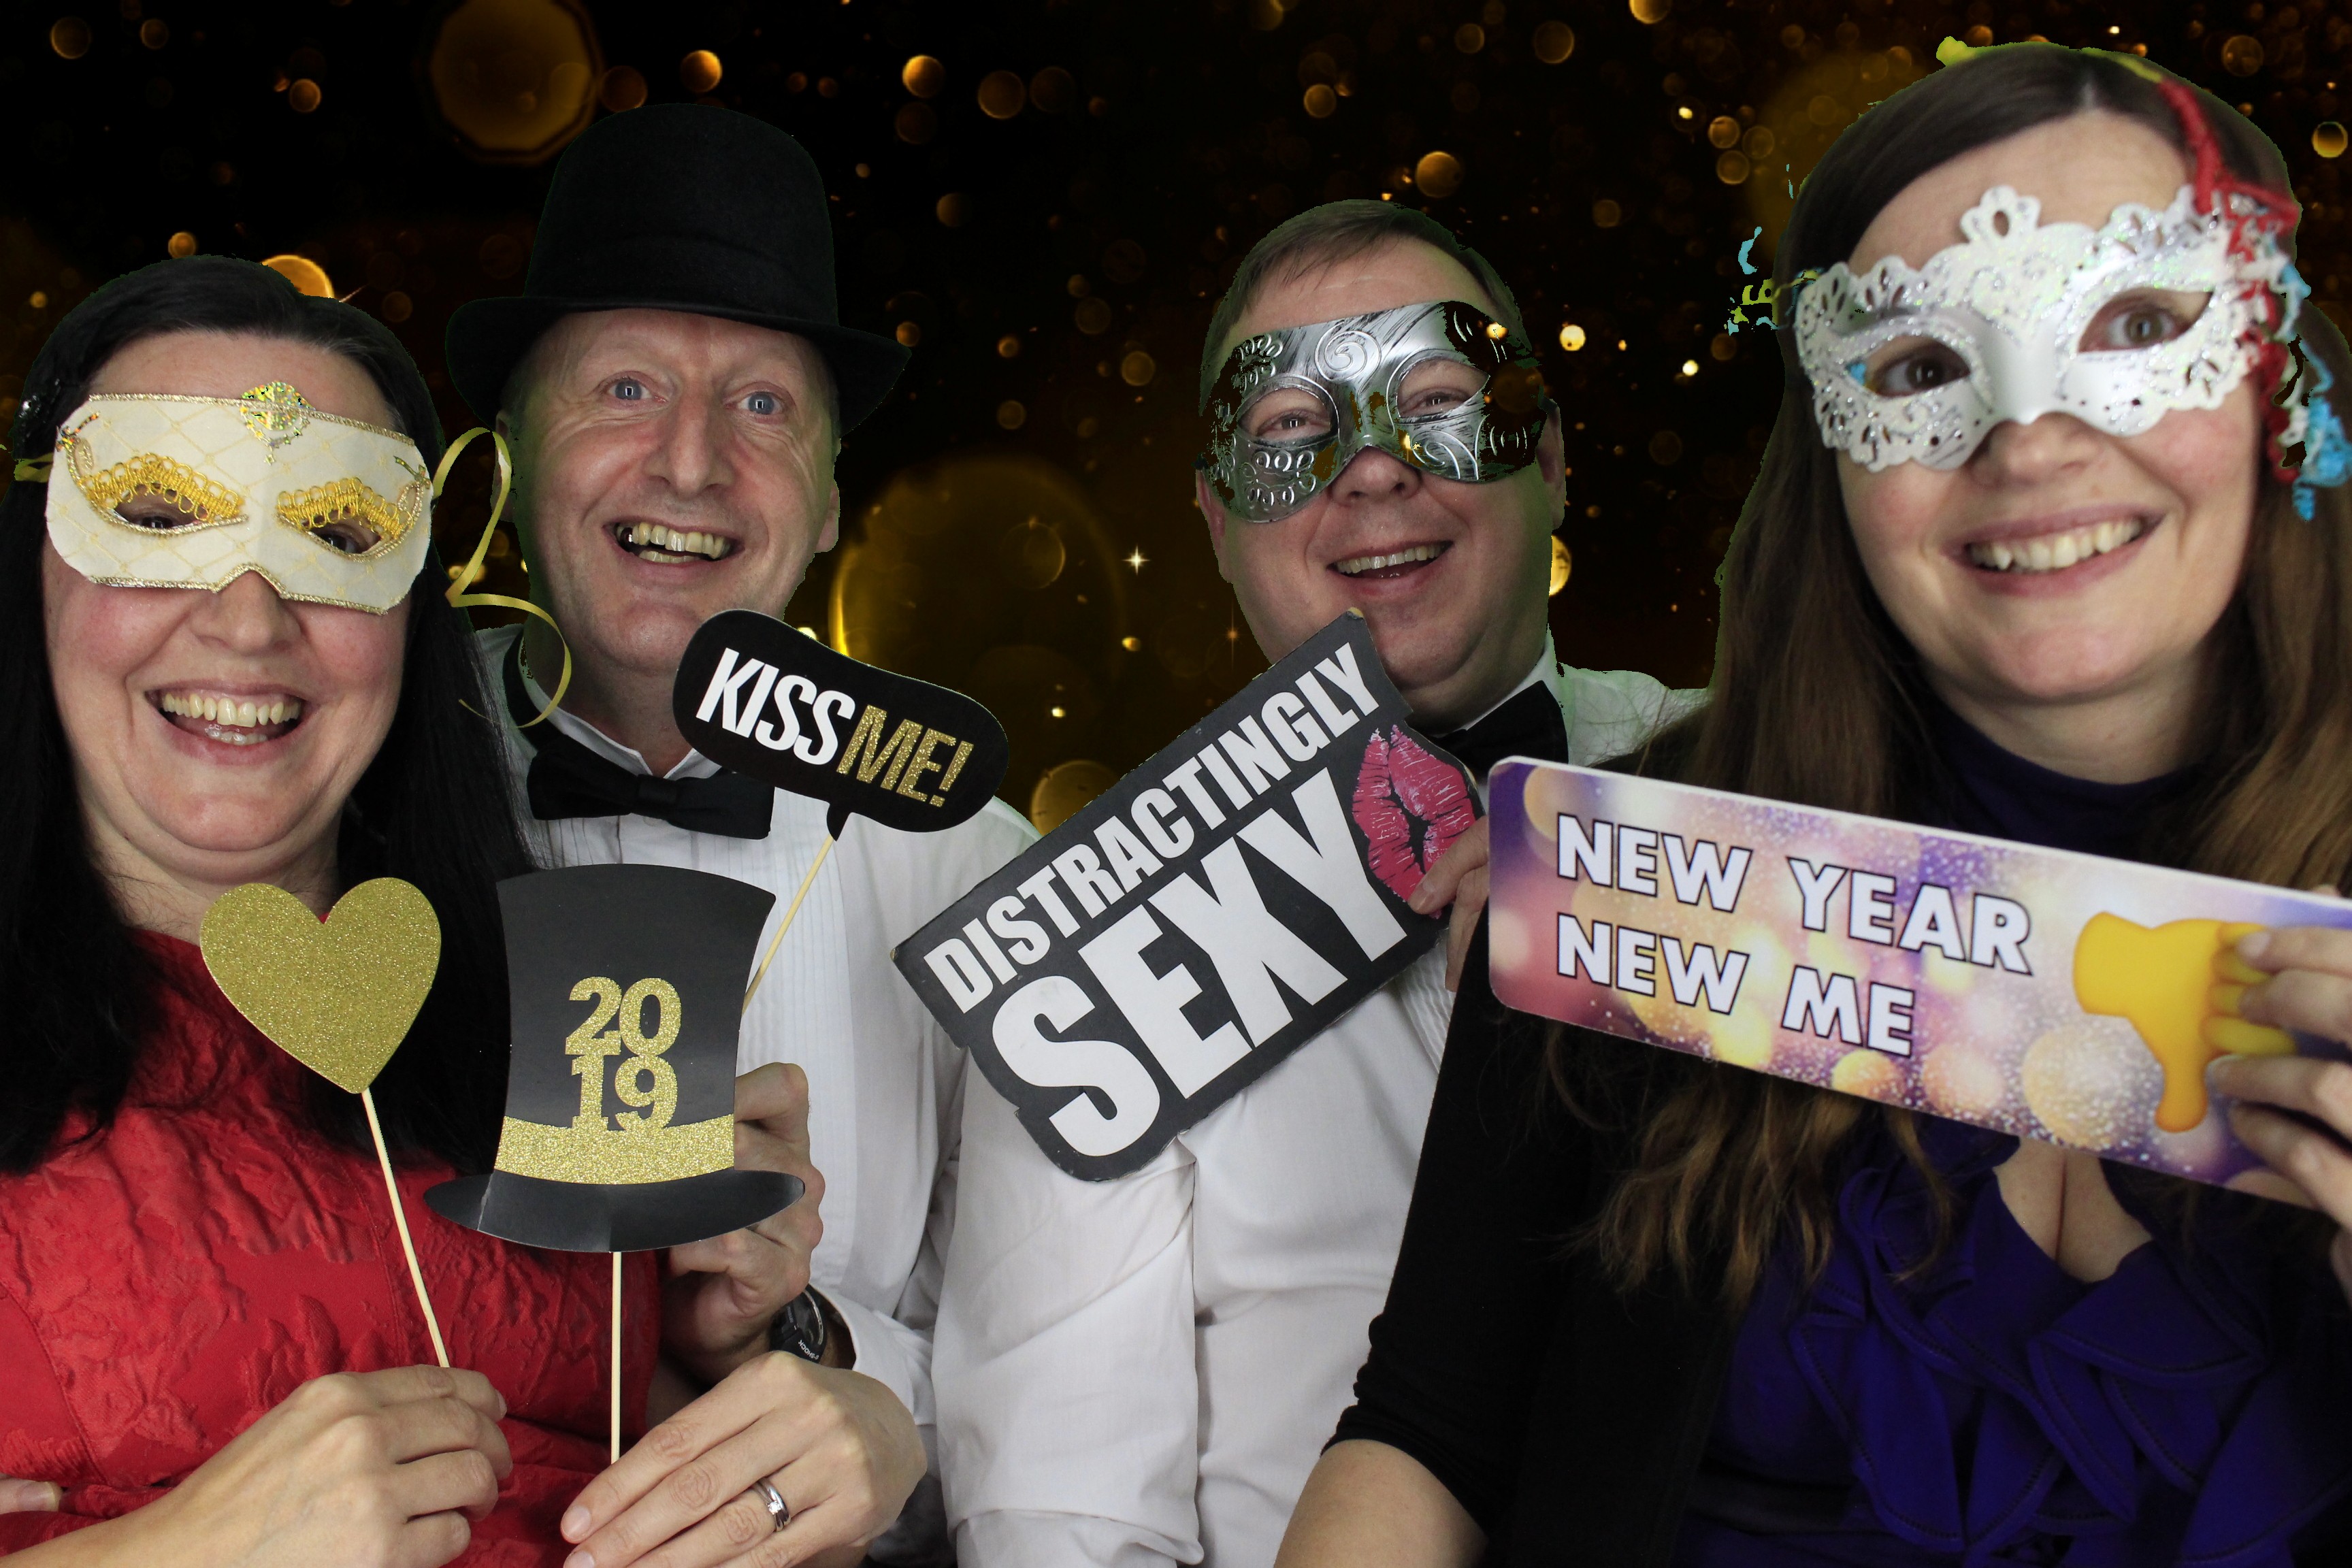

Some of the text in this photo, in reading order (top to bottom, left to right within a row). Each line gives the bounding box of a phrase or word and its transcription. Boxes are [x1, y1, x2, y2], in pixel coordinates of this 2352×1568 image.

[696, 647, 974, 808] KISS ME!
[924, 642, 1379, 1014] DISTRACTINGLY
[1557, 812, 2033, 976] NEW YEAR
[566, 976, 681, 1056] 20
[992, 767, 1407, 1157] SEXY
[1557, 912, 1915, 1057] NEW ME
[571, 1054, 678, 1131] 19
